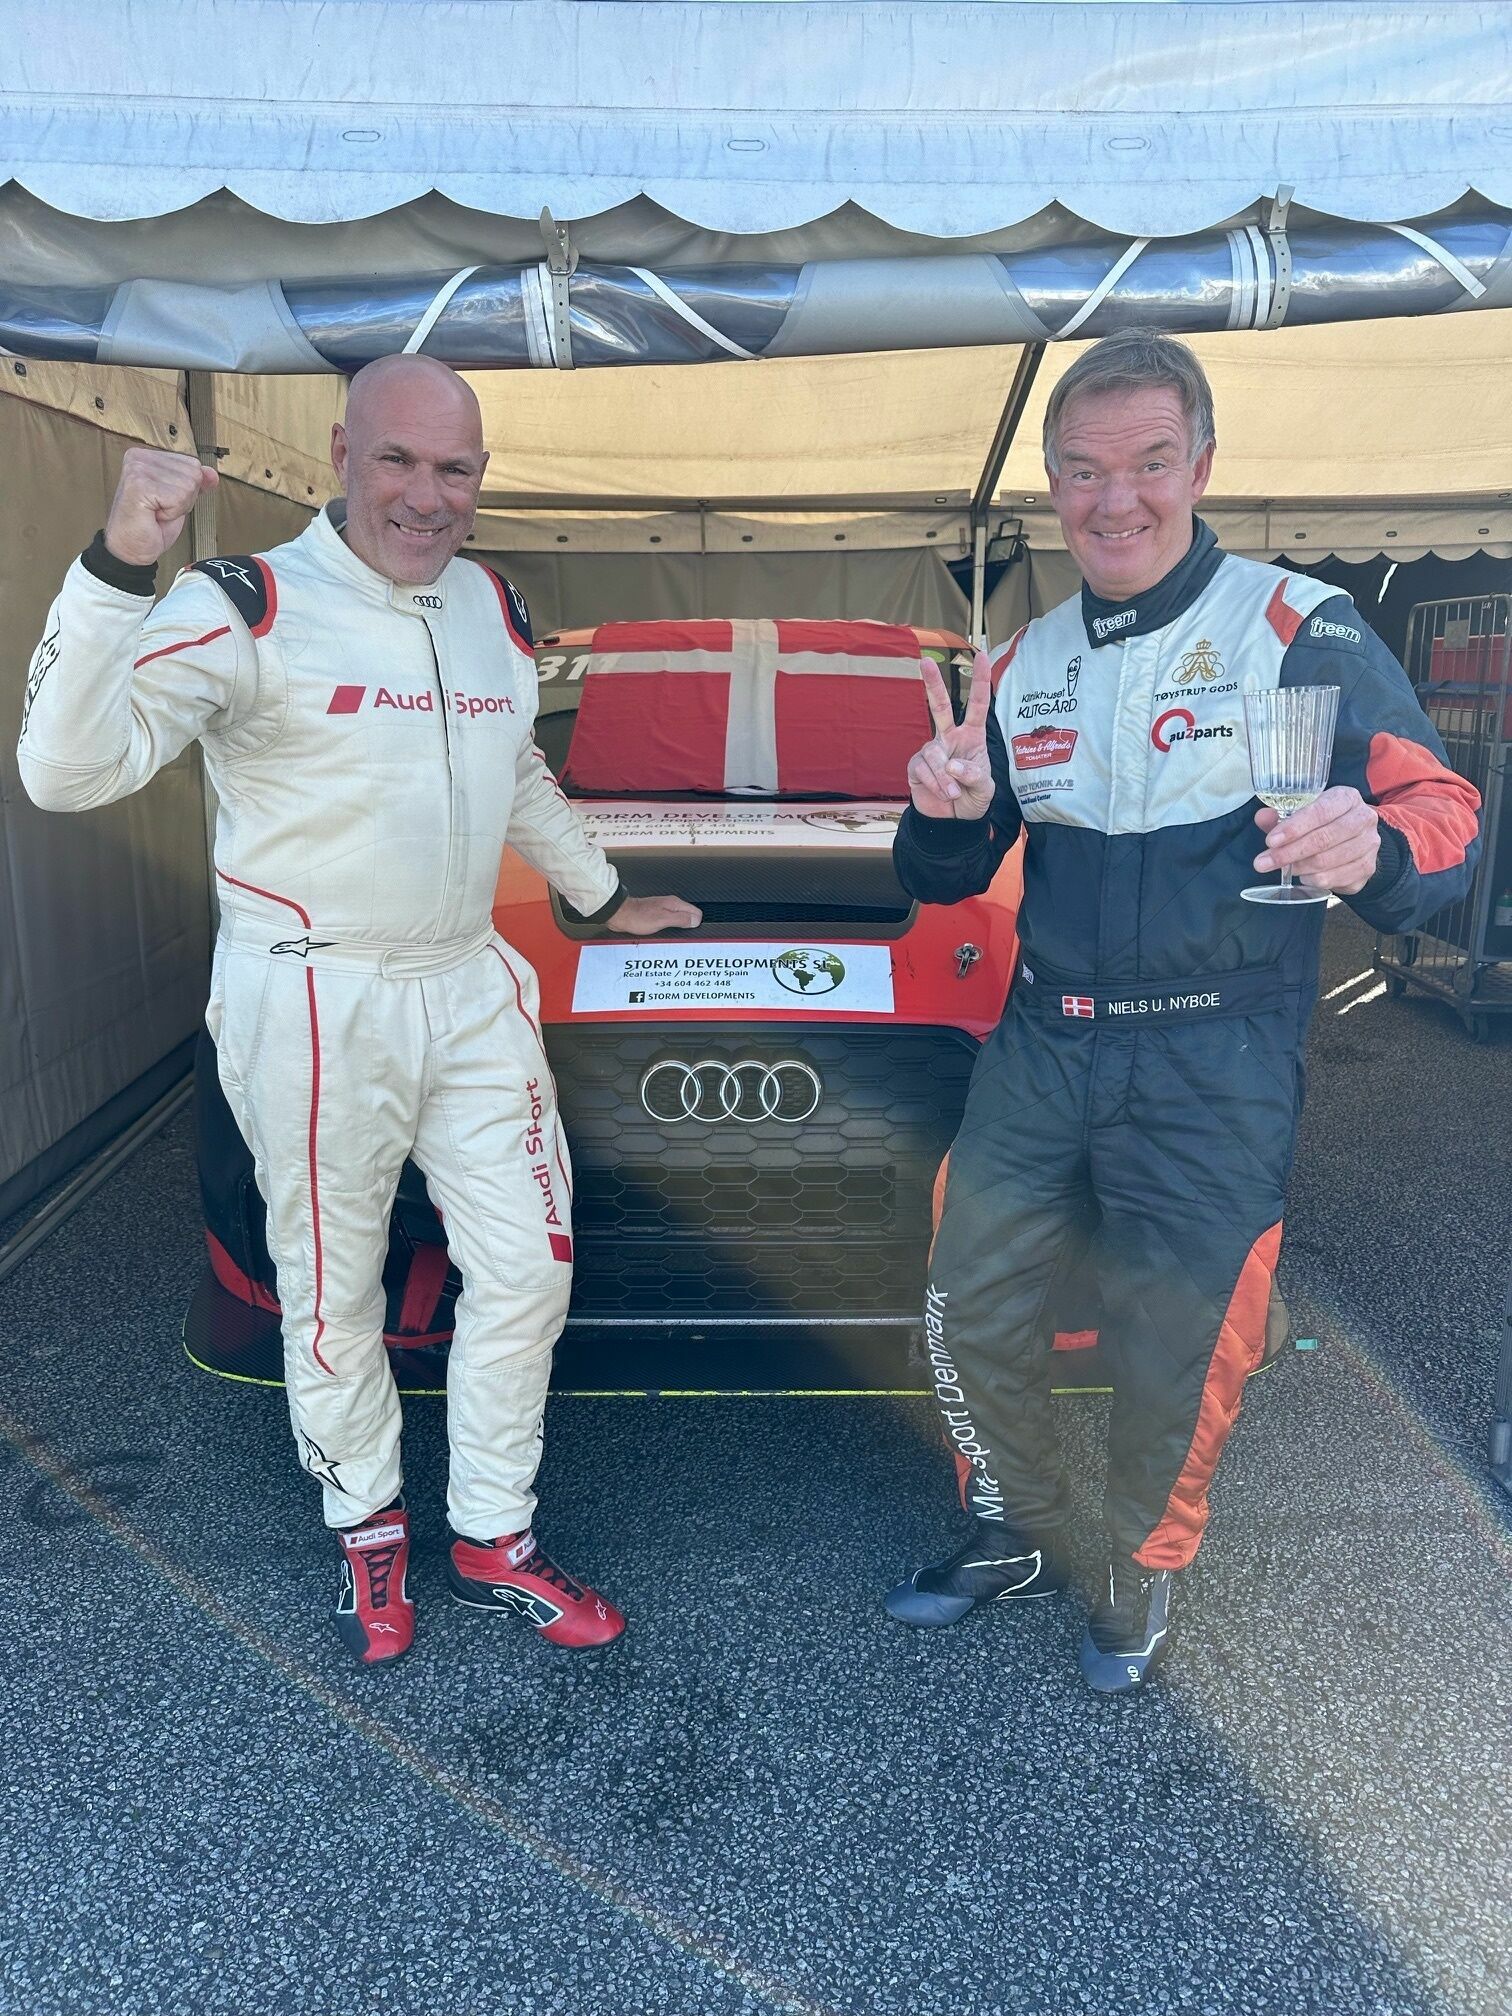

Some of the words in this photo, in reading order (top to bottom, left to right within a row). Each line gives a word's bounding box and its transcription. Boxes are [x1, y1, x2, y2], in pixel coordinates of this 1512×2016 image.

[1093, 609, 1136, 638] freem
[1310, 616, 1361, 643] freem
[373, 686, 452, 713] Audi
[454, 692, 516, 719] Sport
[1154, 686, 1207, 702] TØYSTRUP
[1209, 681, 1238, 694] GODS
[1169, 725, 1233, 743] au2parts
[623, 970, 643, 978] Real
[645, 969, 672, 978] Estate
[683, 969, 722, 979] Property
[723, 969, 749, 978] Spain
[624, 958, 679, 970] STORM
[684, 957, 807, 970] DEVELOPMENTS
[654, 980, 672, 988] +34
[648, 992, 680, 1000] STORM
[683, 991, 756, 1000] DEVELOPMENTS
[1108, 1000, 1149, 1016] NIELS
[1152, 998, 1166, 1013] U.
[1169, 992, 1221, 1010] NYBOE
[525, 1077, 544, 1156] Sport
[532, 1163, 563, 1227] Audi
[924, 1282, 965, 1403] Denmark
[358, 1532, 376, 1542] Audi
[377, 1528, 400, 1539] Sport
